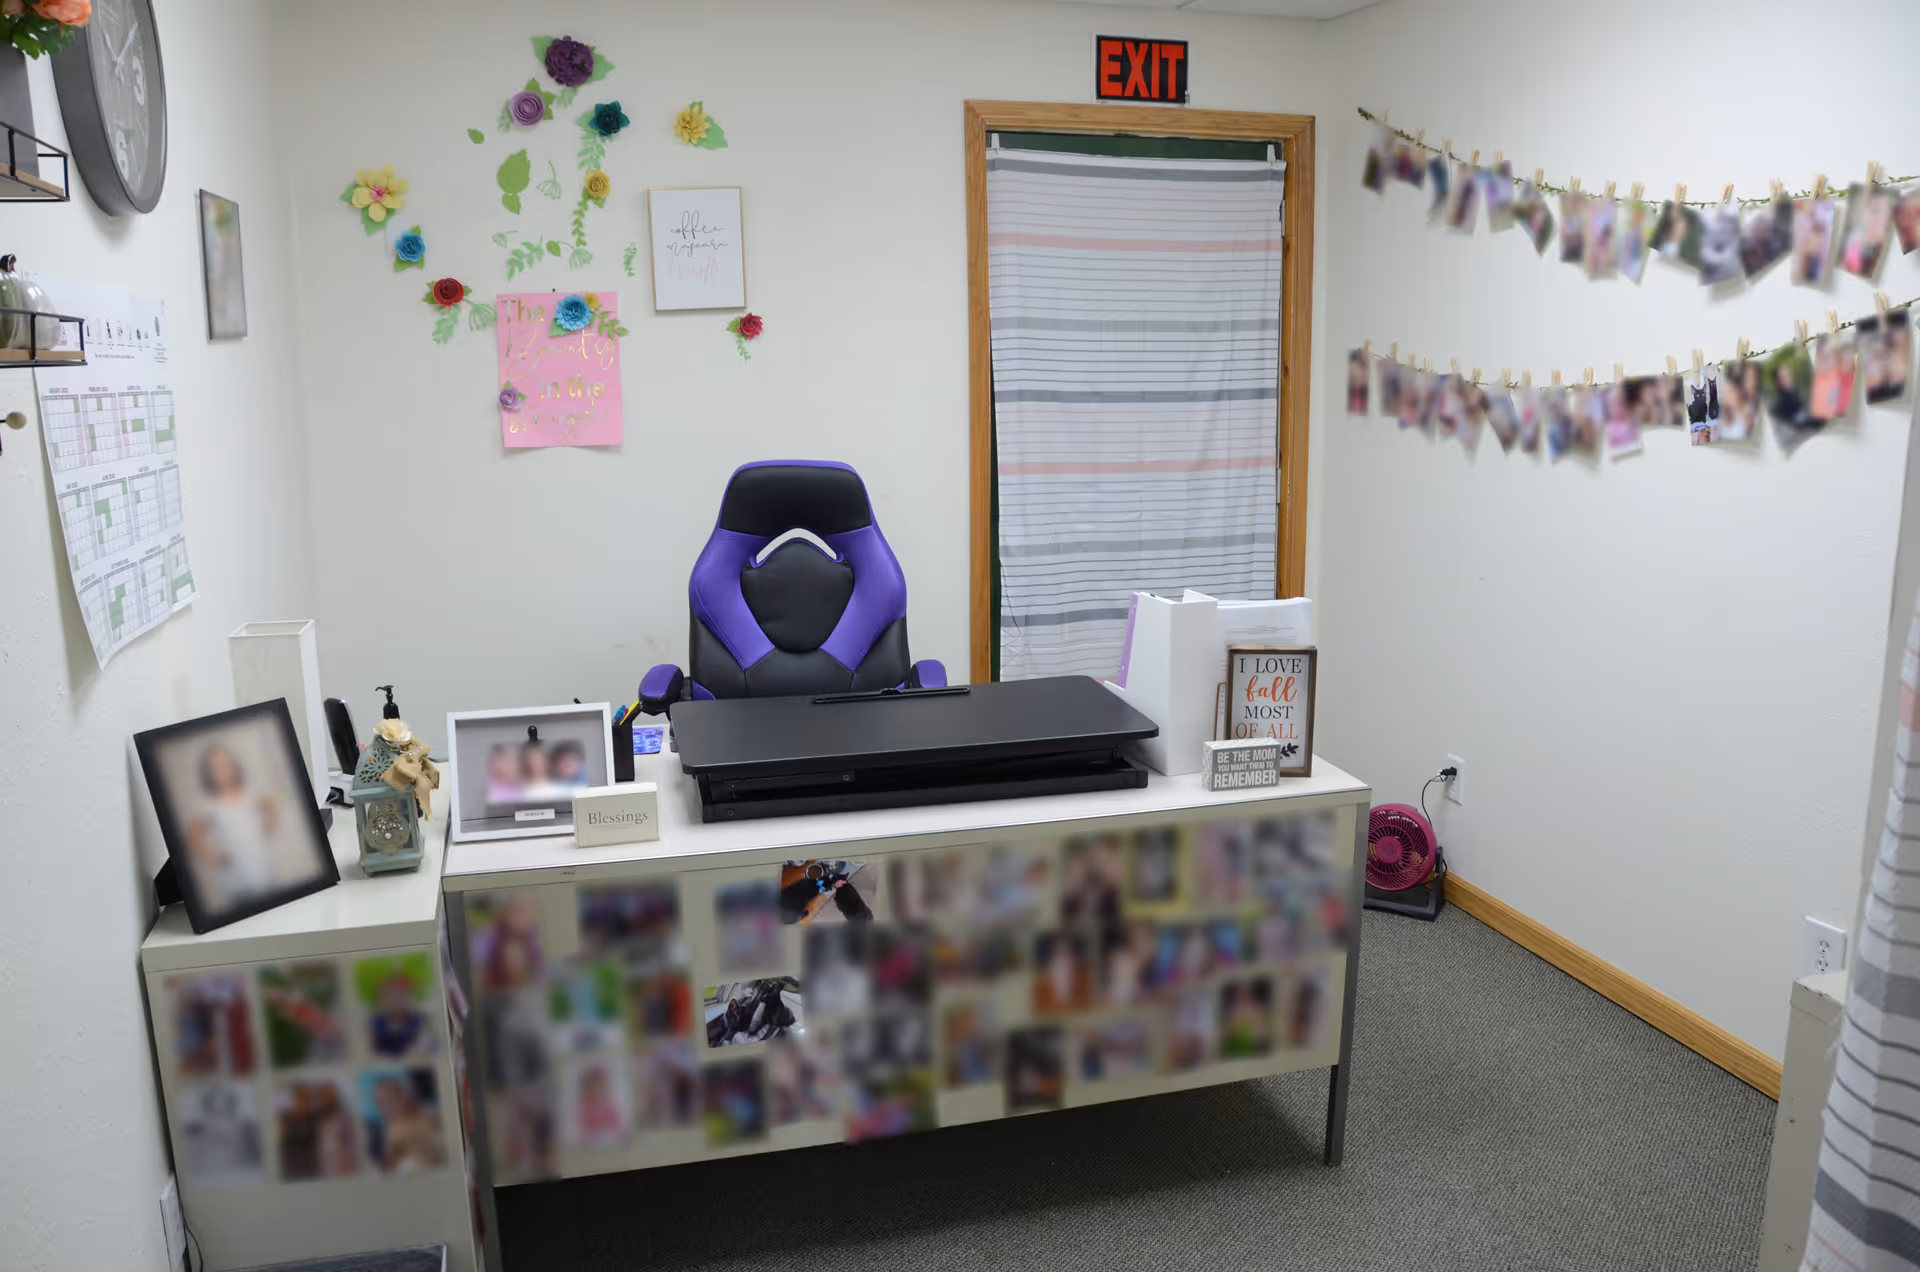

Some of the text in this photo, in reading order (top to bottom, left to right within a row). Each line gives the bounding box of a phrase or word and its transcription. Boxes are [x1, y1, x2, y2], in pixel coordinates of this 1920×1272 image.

[1100, 40, 1185, 99] EXIT
[501, 299, 546, 324] The
[540, 374, 605, 399] in the
[1239, 658, 1302, 674] I LOVE
[1244, 675, 1298, 702] fall
[1244, 705, 1294, 719] MOST
[1235, 723, 1299, 739] OF ALL
[1217, 748, 1276, 764] BE THE MOM
[1217, 760, 1274, 773] YOU WANT THEM TO
[1214, 769, 1276, 788] REMEMBER
[588, 810, 648, 825] Blessings
